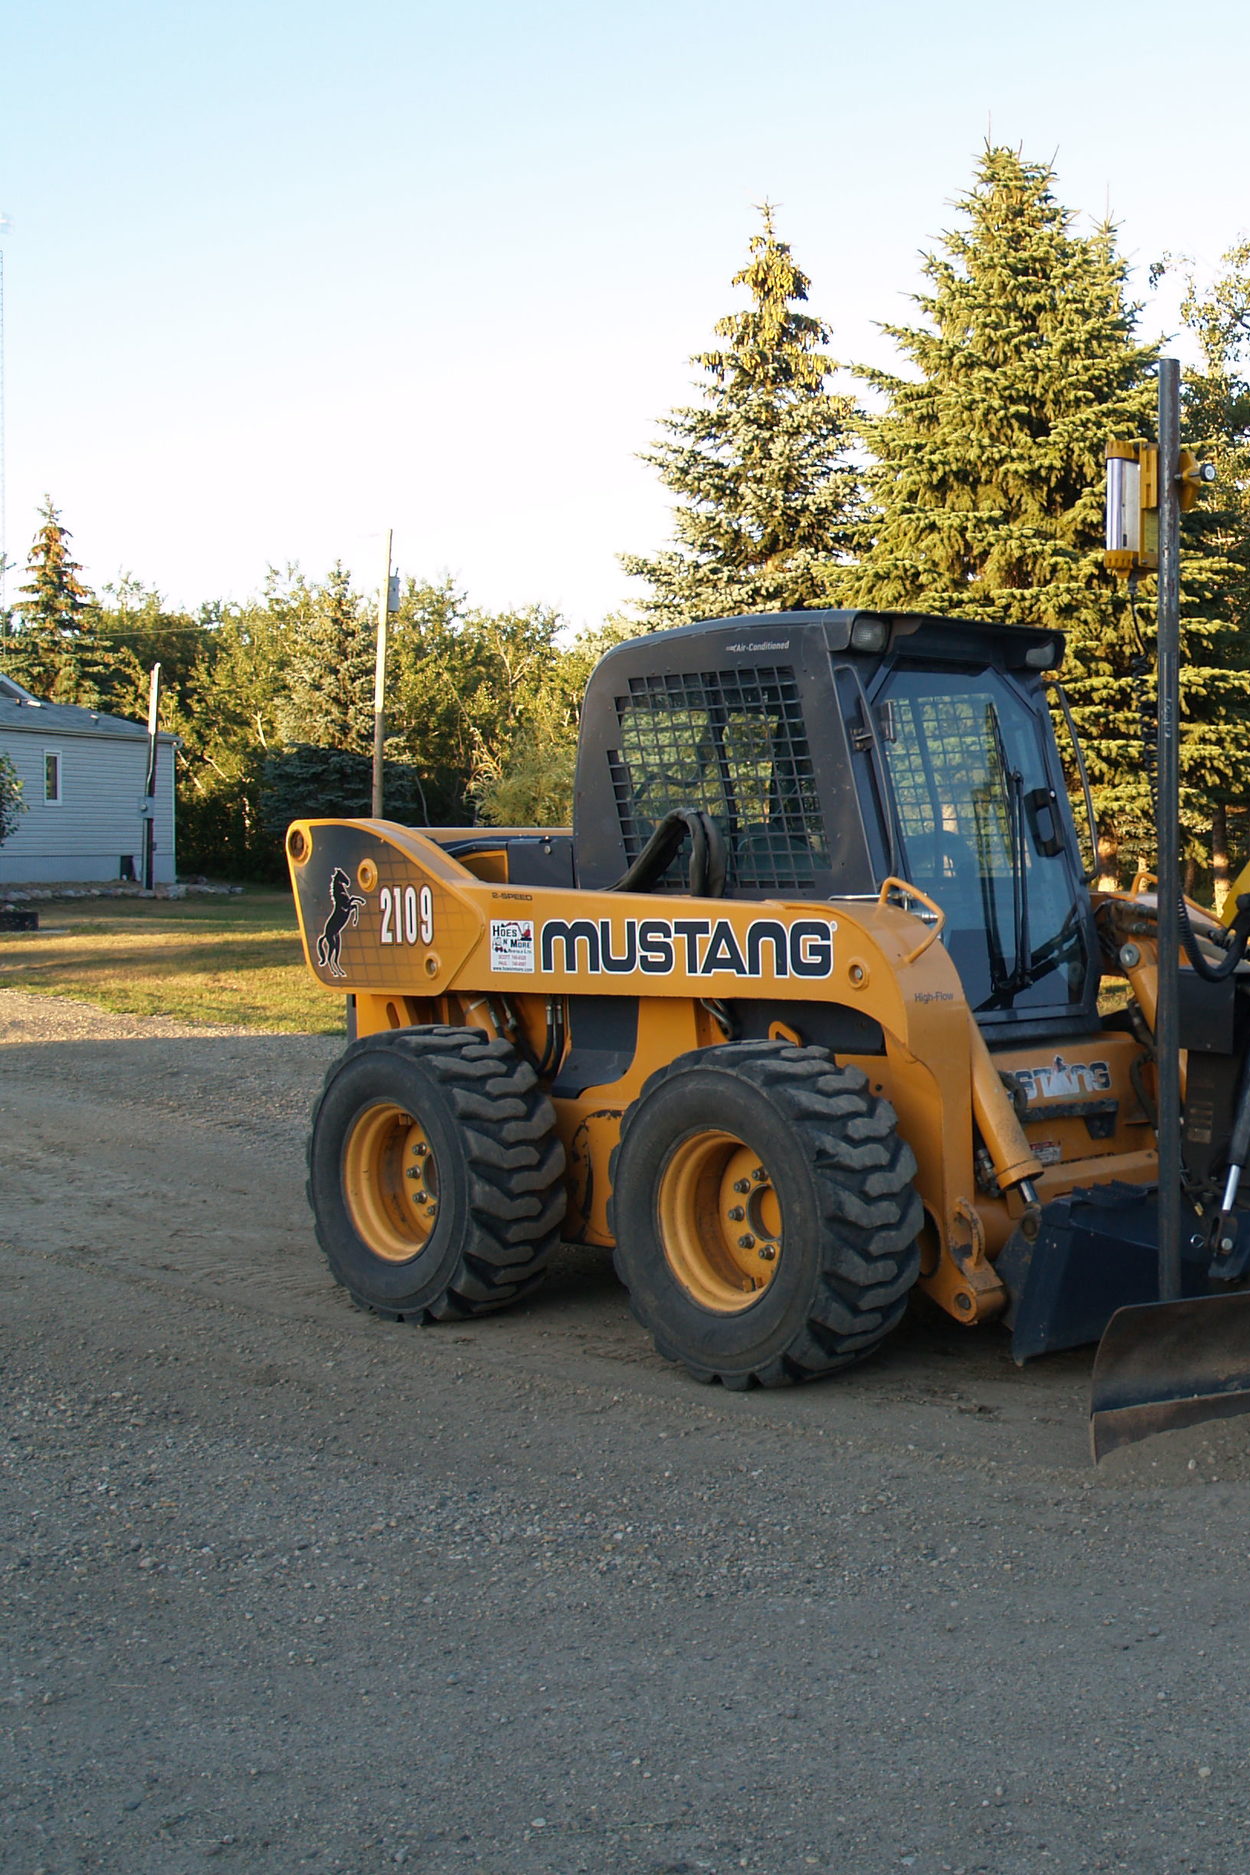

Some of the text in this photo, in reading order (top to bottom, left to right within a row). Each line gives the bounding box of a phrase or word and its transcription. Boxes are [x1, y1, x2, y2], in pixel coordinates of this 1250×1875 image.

[491, 892, 533, 901] 2-SPEED
[379, 884, 434, 946] 2109
[492, 925, 518, 937] HOES
[510, 939, 531, 949] MORE
[541, 919, 834, 979] MUSTANG
[914, 991, 954, 1004] High-Flow
